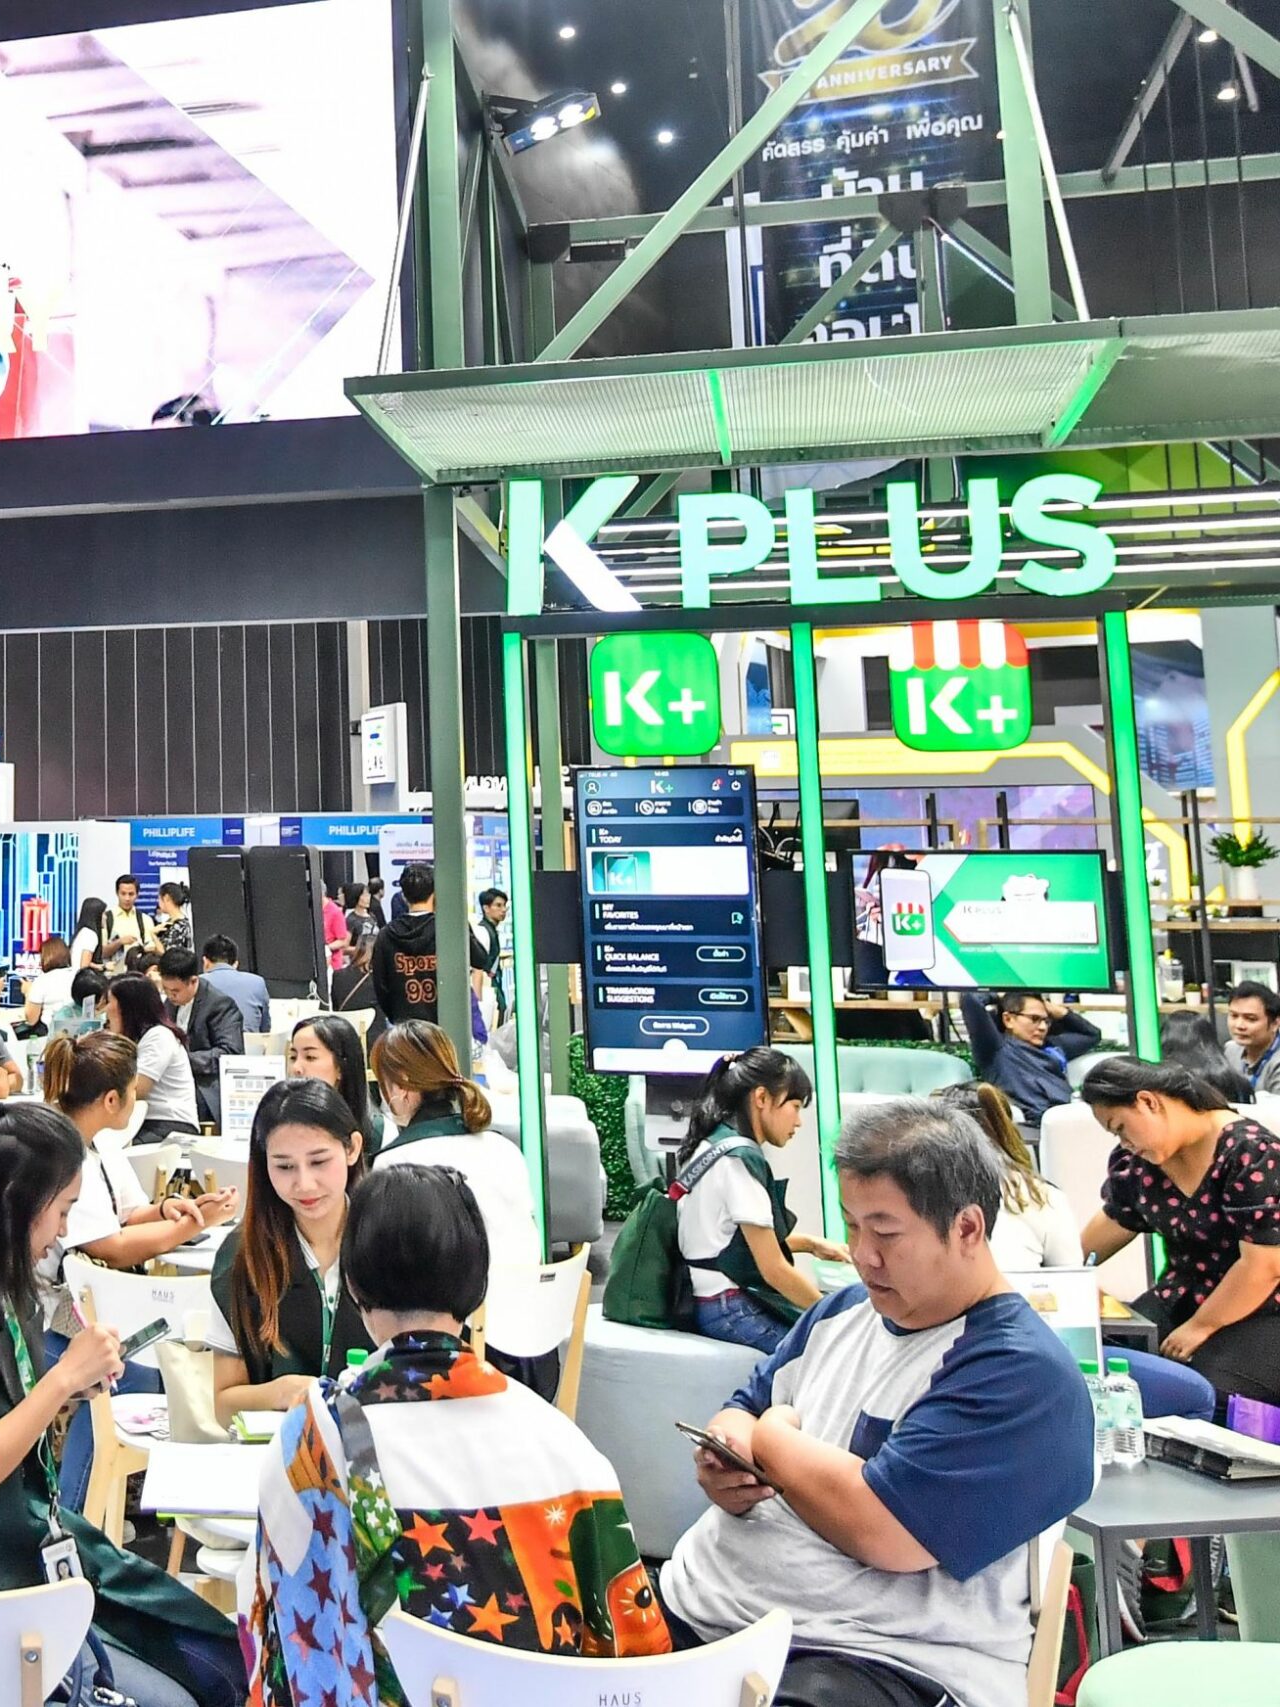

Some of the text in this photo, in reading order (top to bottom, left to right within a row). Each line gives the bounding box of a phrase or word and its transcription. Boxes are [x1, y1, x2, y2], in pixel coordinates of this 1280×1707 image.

[816, 54, 954, 90] ANNIVERSARY
[508, 473, 1117, 616] K PLUS
[602, 669, 706, 727] K+
[905, 676, 1019, 735] K+
[650, 779, 674, 794] K+
[142, 827, 196, 838] PHILLIPLIFE
[602, 911, 640, 919] FAVORITES
[895, 914, 922, 931] K+
[627, 953, 660, 961] BALANCE
[405, 979, 437, 1003] 99
[606, 987, 655, 996] TRANSACTION
[606, 995, 655, 1004] SUGGESTIONS
[599, 1691, 641, 1707] HAUS
